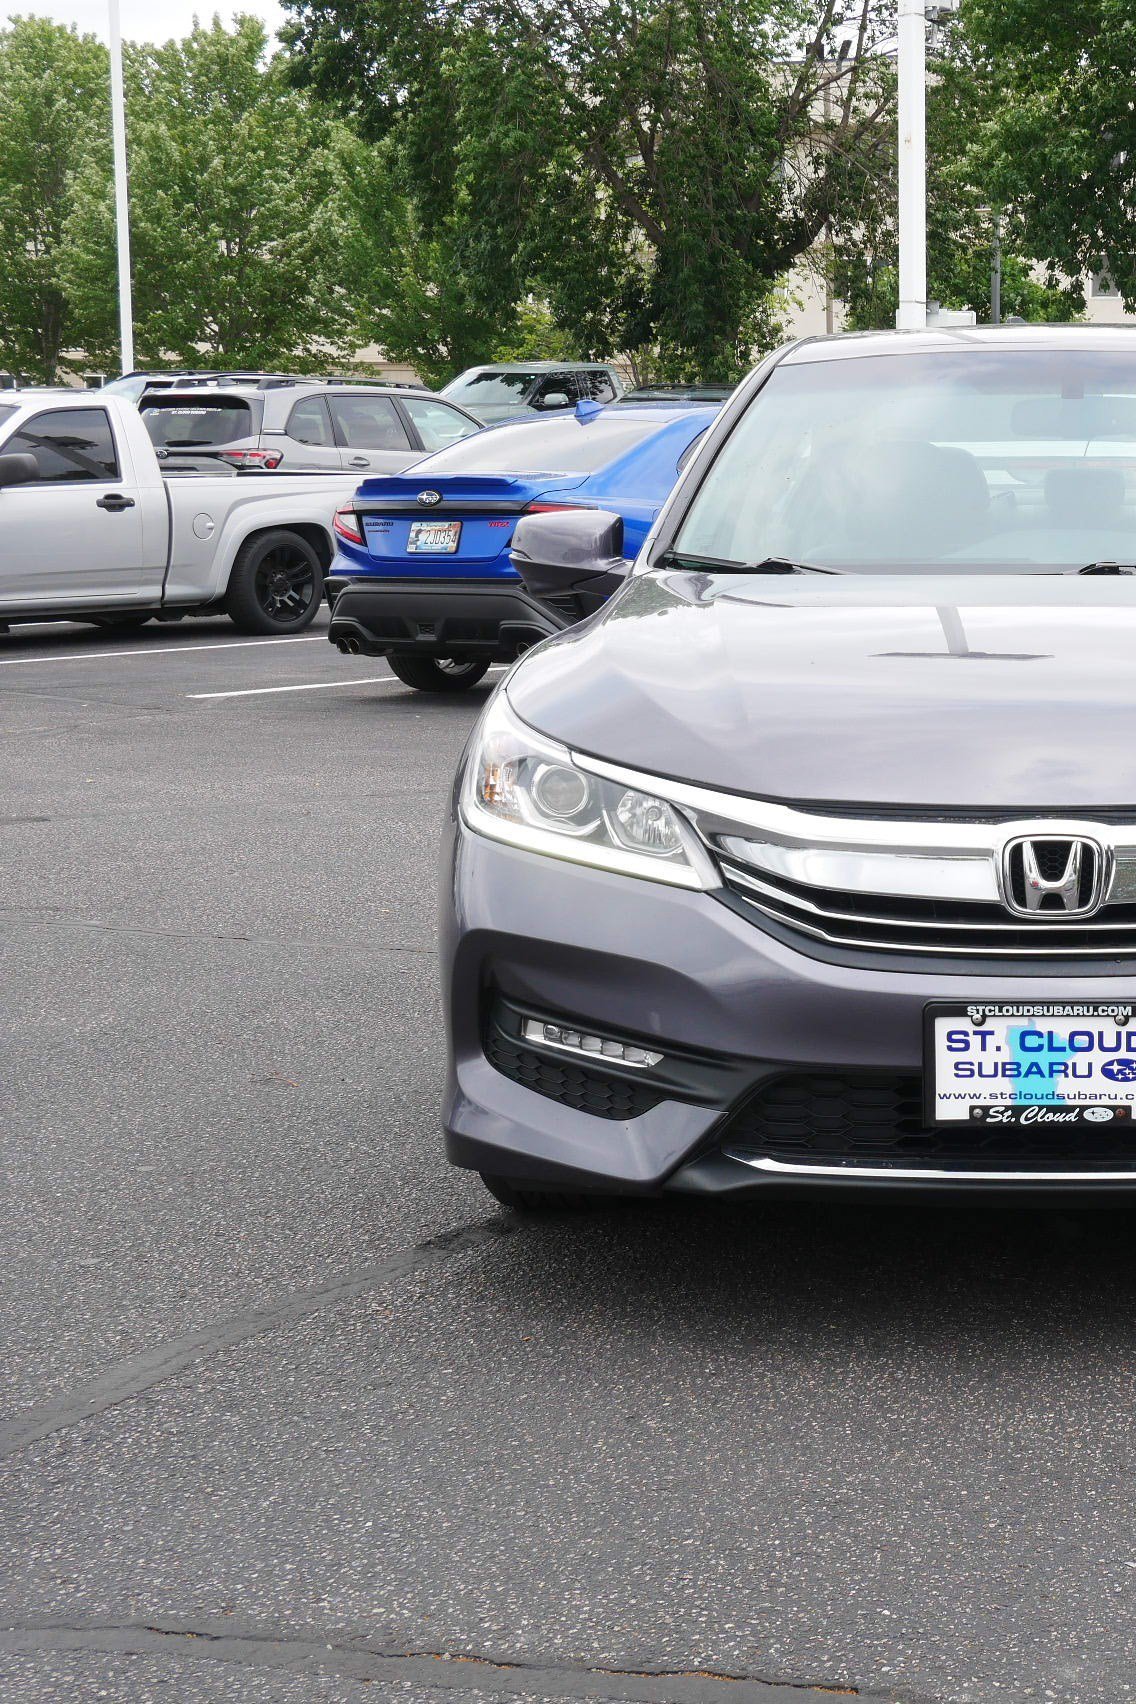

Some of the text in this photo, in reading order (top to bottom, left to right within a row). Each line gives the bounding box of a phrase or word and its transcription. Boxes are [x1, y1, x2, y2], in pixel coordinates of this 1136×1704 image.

[967, 1006, 1132, 1016] STCLOUDSUBARU.COM
[946, 1030, 1001, 1053] ST.
[953, 1061, 1093, 1079] SUBARU
[986, 1106, 1079, 1124] St. Cloud
